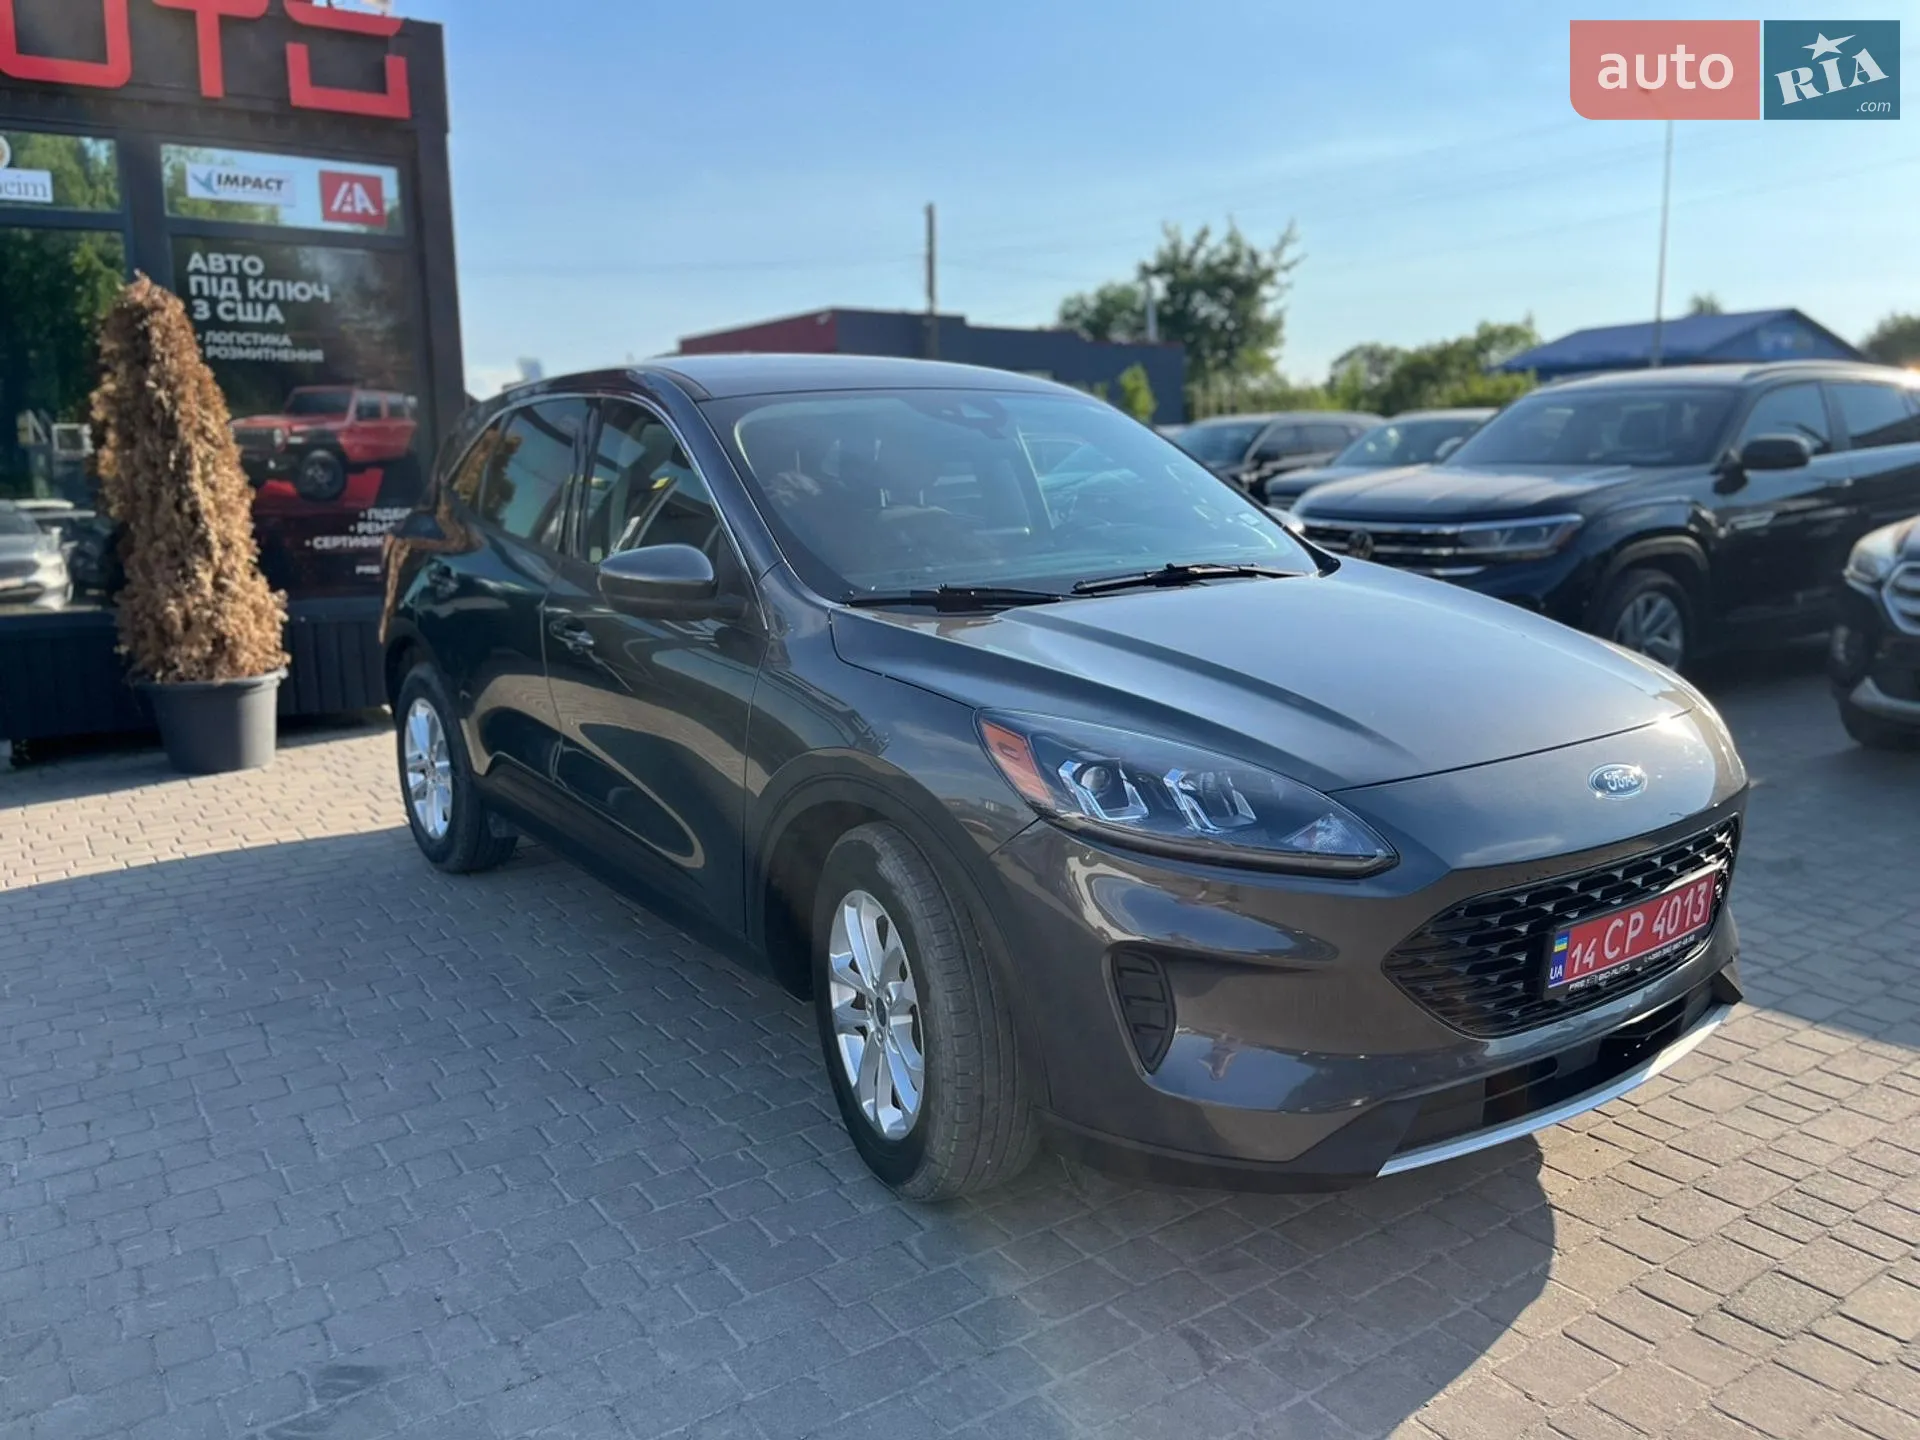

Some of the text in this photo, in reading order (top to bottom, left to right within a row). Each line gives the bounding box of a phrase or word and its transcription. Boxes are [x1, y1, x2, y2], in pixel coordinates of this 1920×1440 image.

[217, 173, 284, 192] IMPACT
[186, 251, 265, 277] АВТО
[189, 275, 331, 303] ПІД КЛЮЧ
[216, 299, 285, 324] США
[205, 330, 293, 347] ЛОГІСТИКА
[1571, 937, 1598, 974] 14
[1652, 882, 1708, 941] 4013
[1550, 964, 1563, 980] UA
